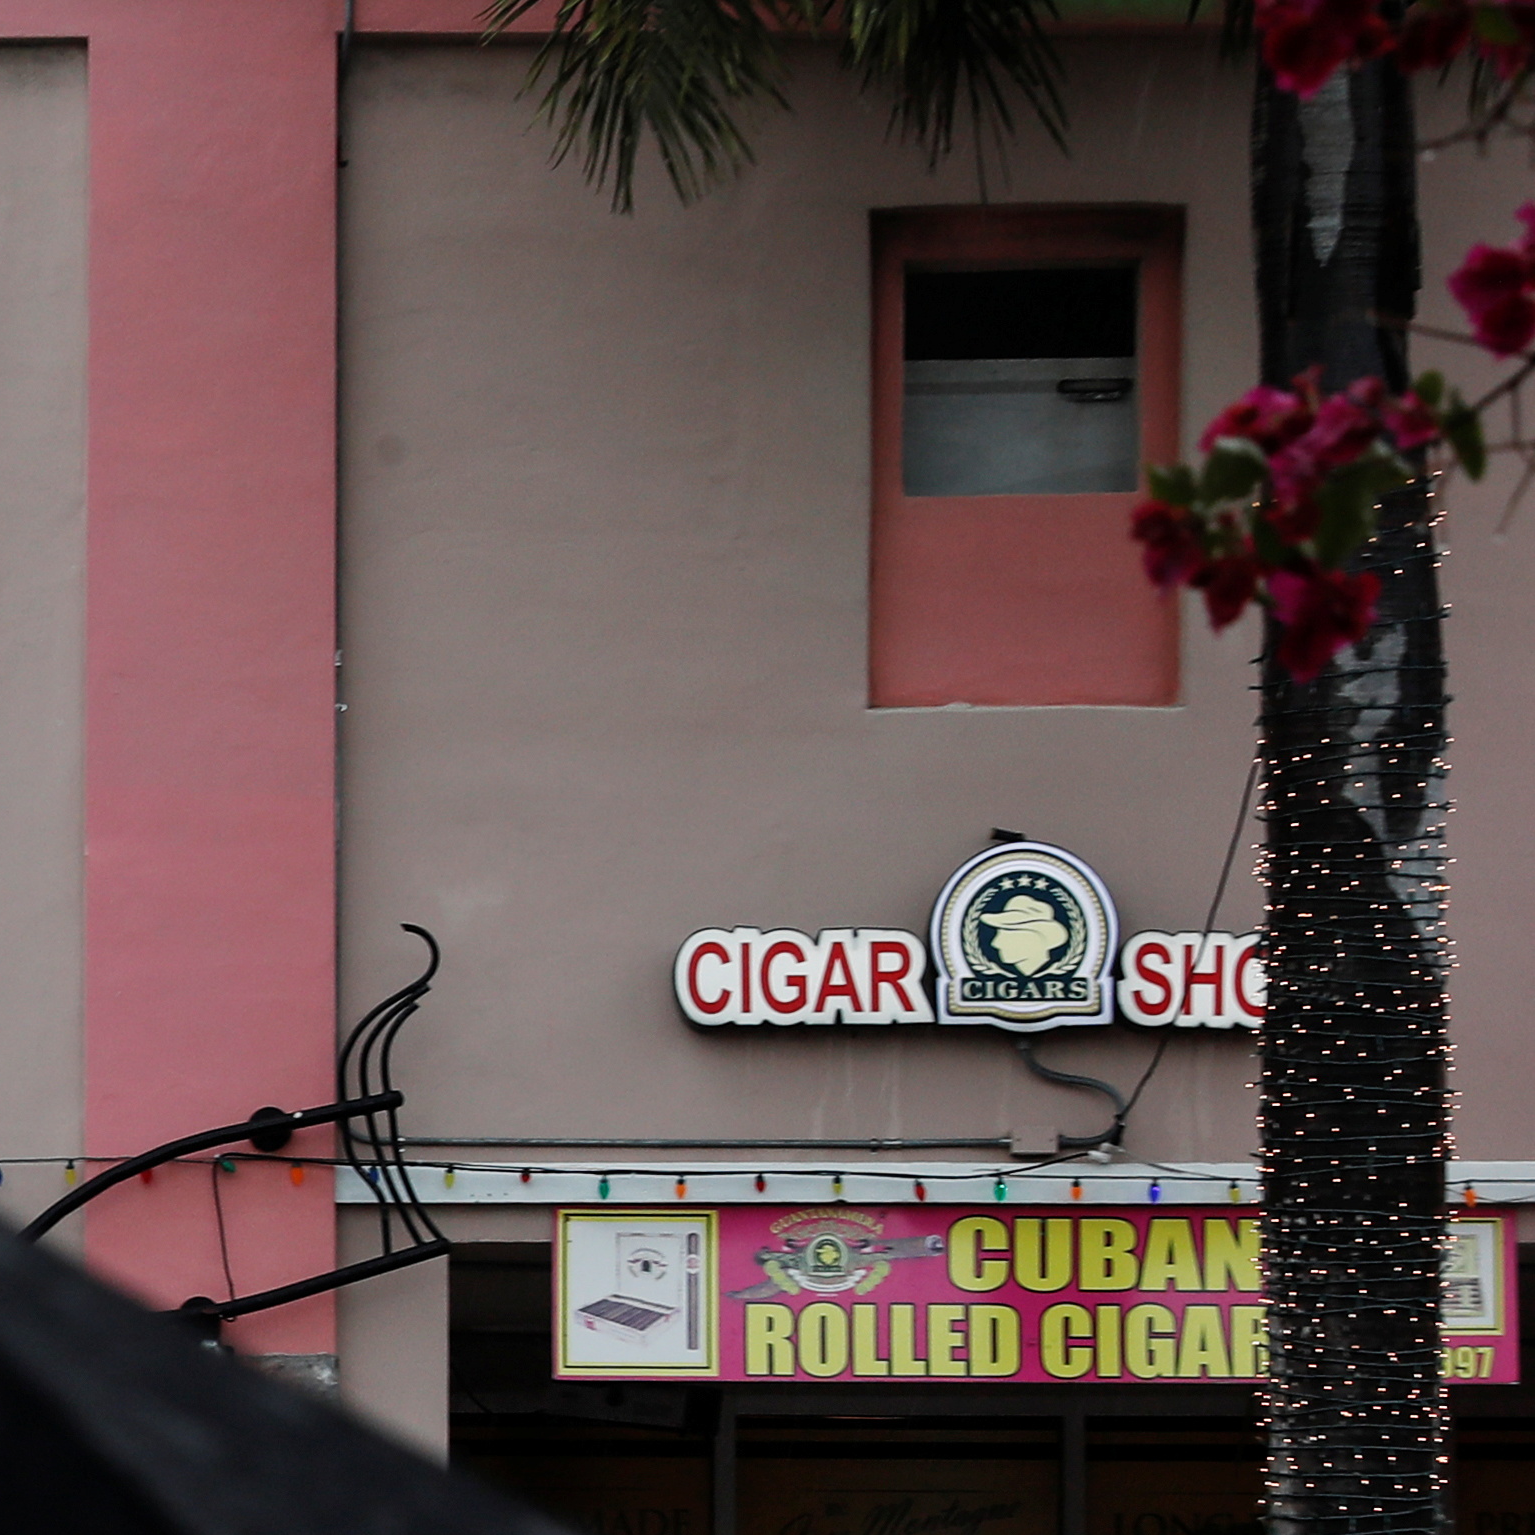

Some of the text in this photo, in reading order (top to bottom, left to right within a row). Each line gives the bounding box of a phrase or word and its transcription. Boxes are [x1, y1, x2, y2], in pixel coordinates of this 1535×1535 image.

[688, 941, 1268, 1017] CIGAR SHO
[962, 980, 1088, 1000] CIGARS
[947, 1215, 1263, 1293] CUBAN
[745, 1302, 1271, 1379] ROLLED CIGAR
